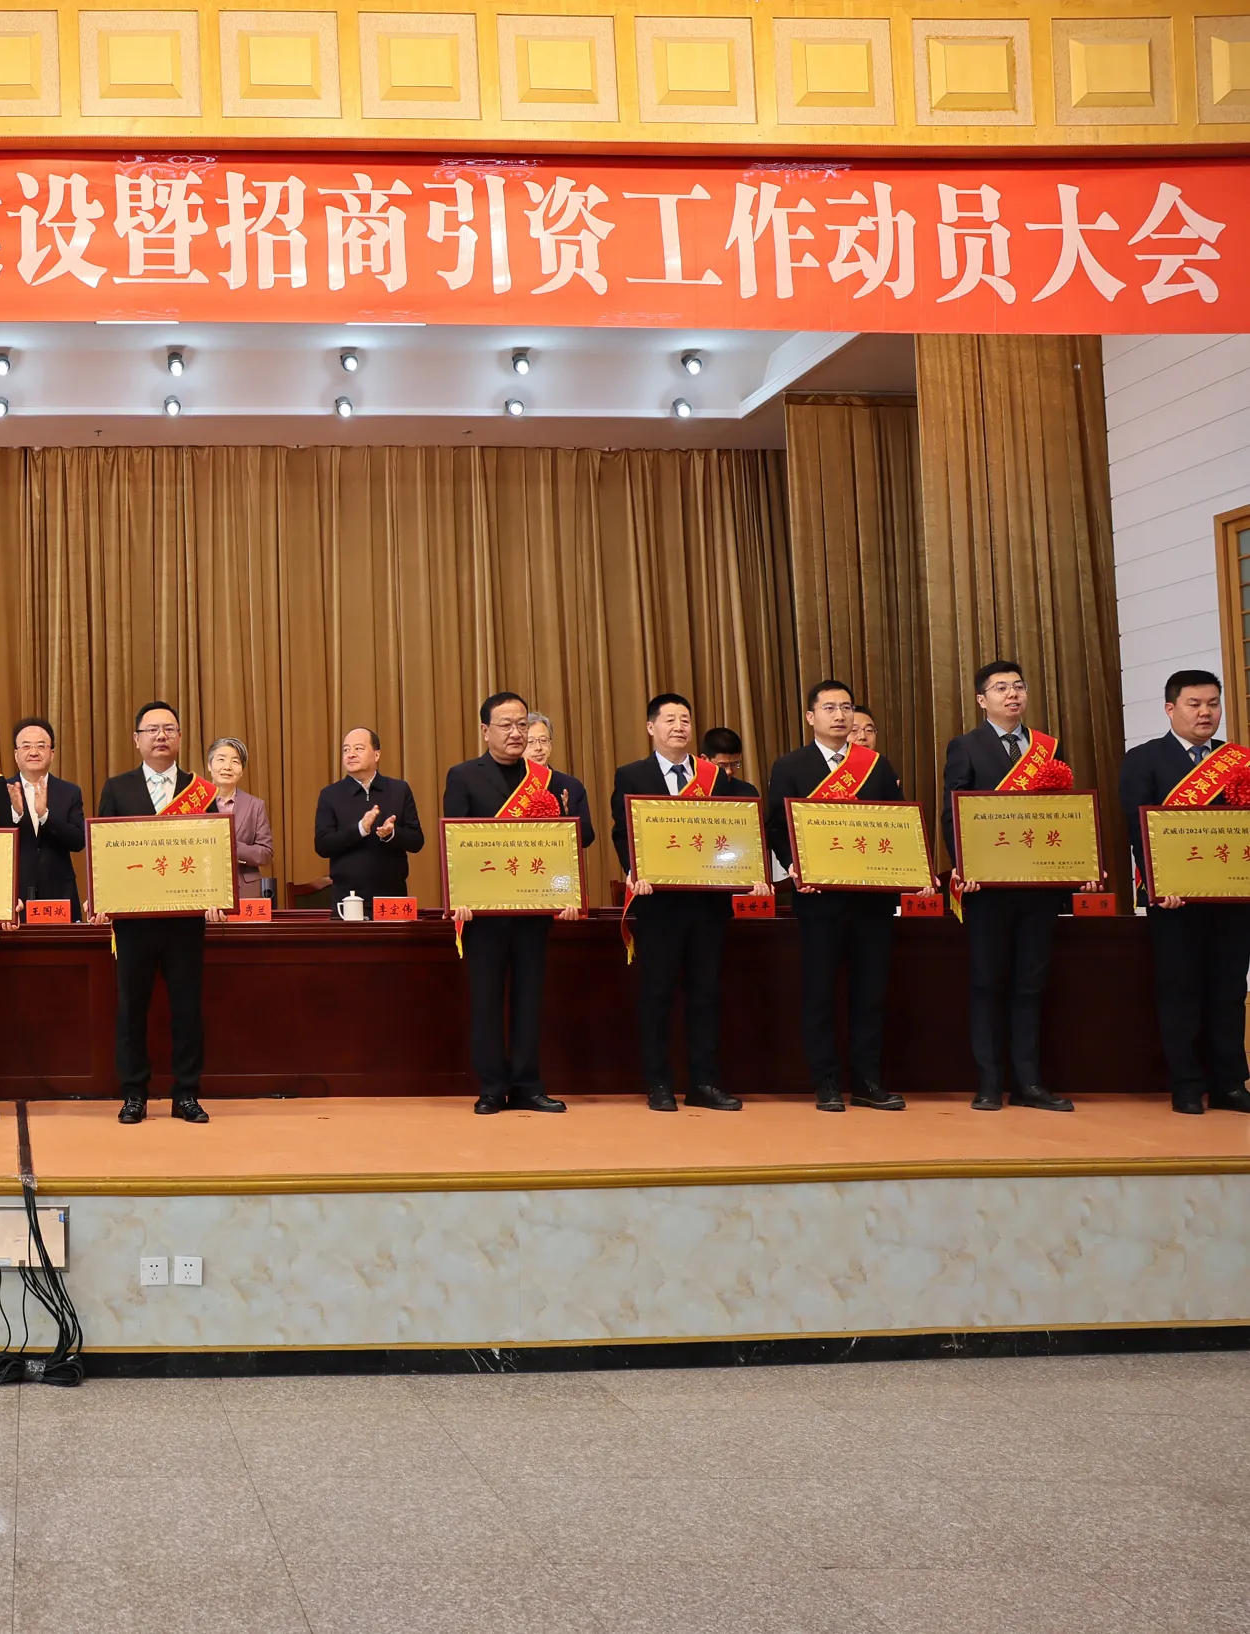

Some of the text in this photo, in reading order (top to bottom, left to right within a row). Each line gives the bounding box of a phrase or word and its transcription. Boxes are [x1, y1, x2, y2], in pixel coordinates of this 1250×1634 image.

[666, 833, 730, 852] 三等奖
[829, 835, 894, 854] 三等奖
[994, 828, 1062, 849] 三等奖
[126, 855, 197, 877] 一等奖
[480, 856, 546, 876] 二等奖
